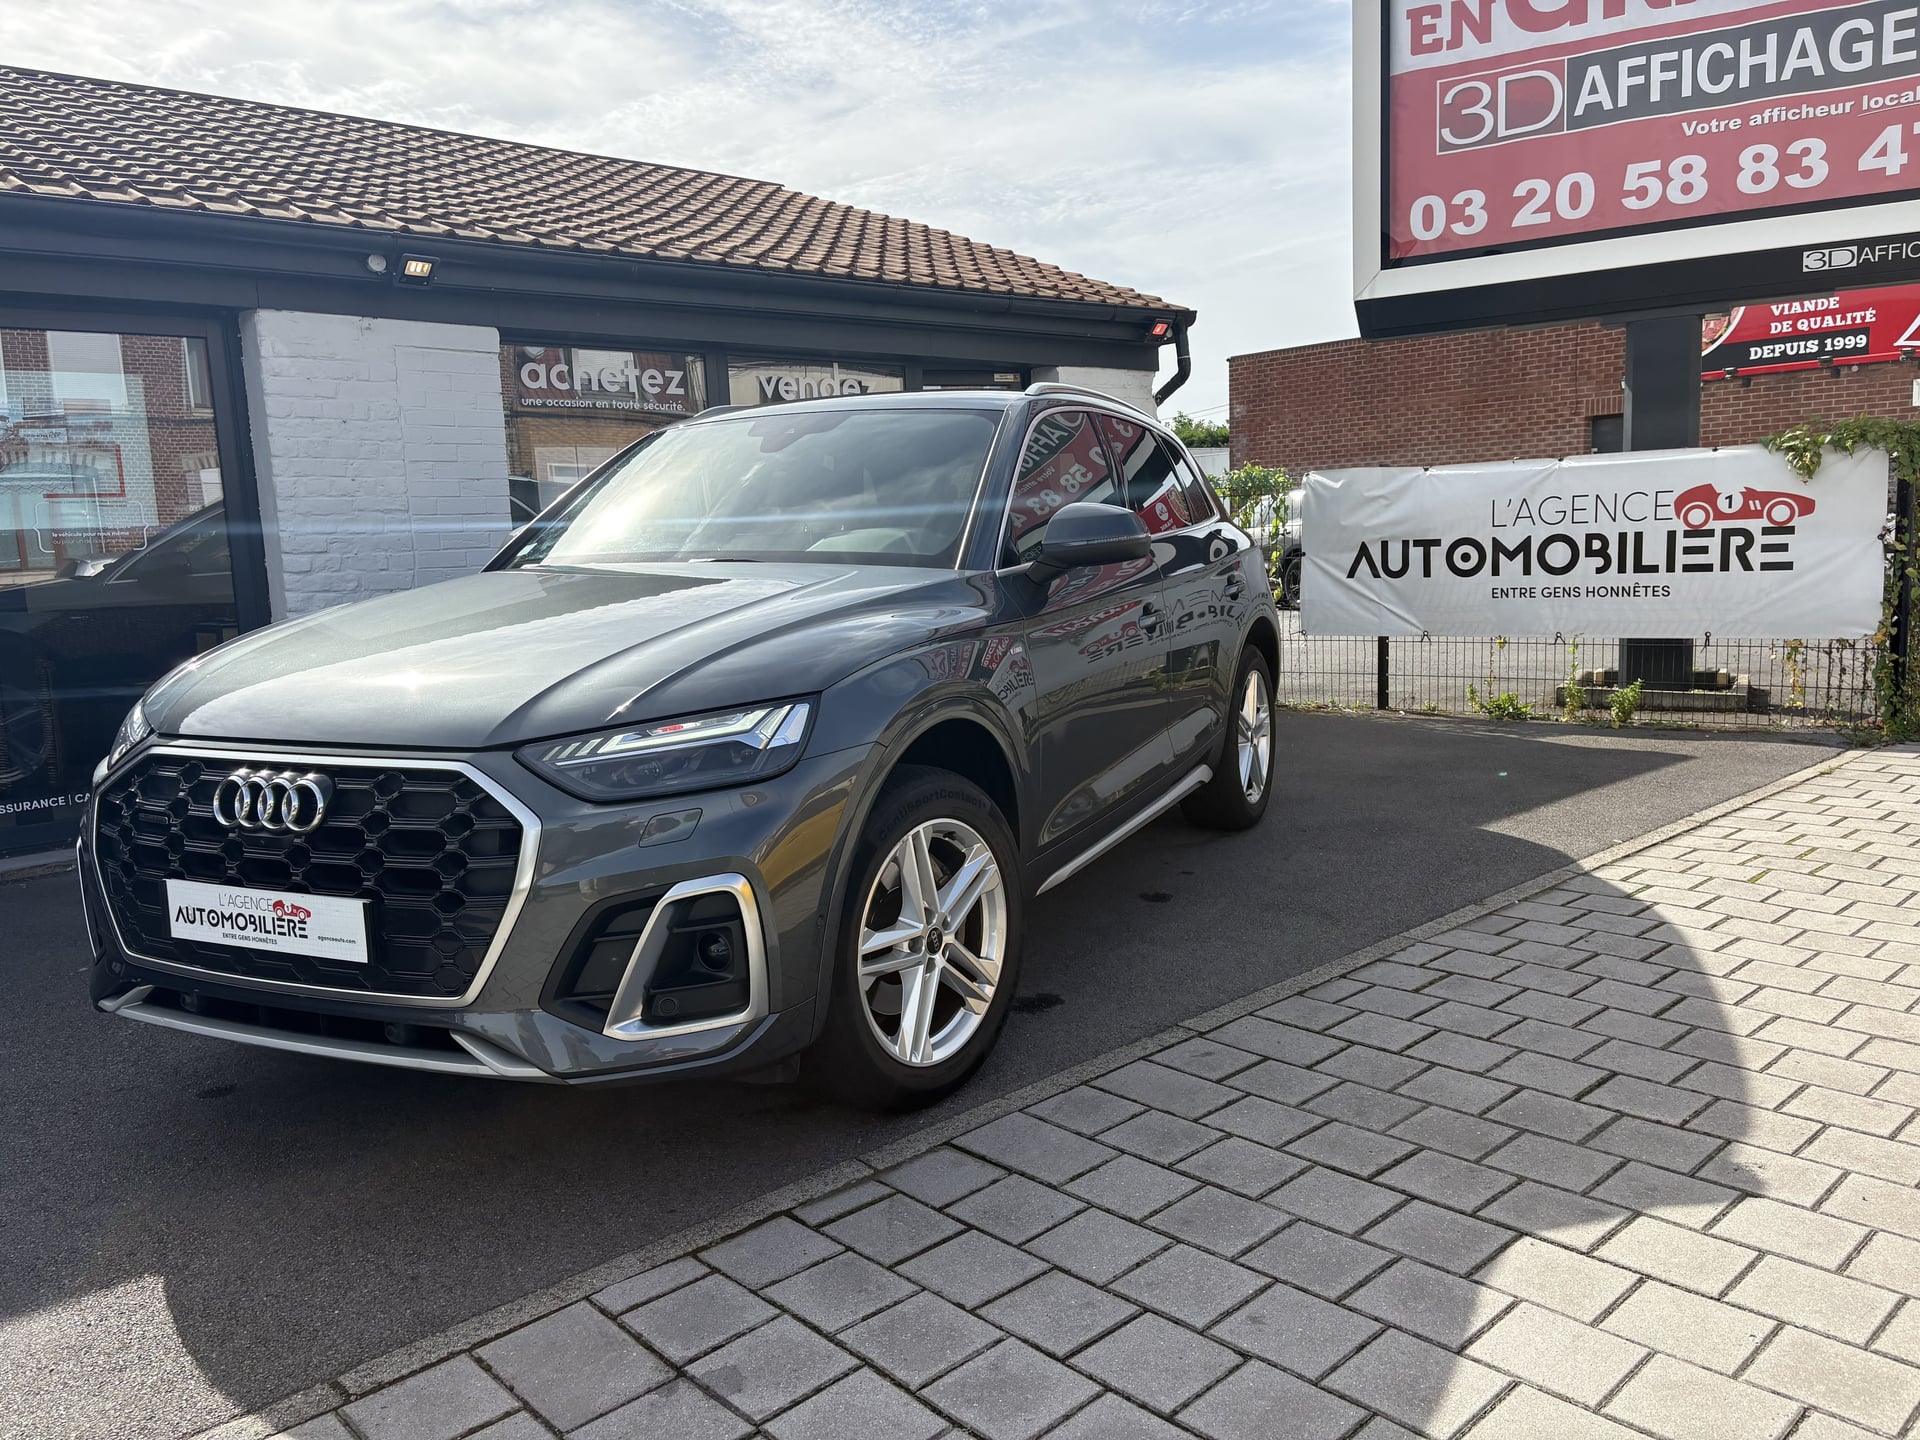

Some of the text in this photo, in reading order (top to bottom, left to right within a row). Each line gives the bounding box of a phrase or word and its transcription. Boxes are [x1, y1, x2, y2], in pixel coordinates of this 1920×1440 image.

[1440, 7, 1919, 146] 3D AFFICHAGE
[1681, 116, 1743, 137] Votre
[1749, 101, 1856, 127] afficheur
[1409, 121, 1920, 241] 03 20 58 83 4
[1804, 248, 1856, 270] 3D
[1770, 296, 1840, 317] VIANDE
[1770, 308, 1877, 335] DE QUALITÉ
[1749, 334, 1868, 361] DEPUIS 1999
[520, 358, 685, 395] achetez
[521, 398, 543, 407] une
[546, 396, 593, 409] occasion
[596, 401, 609, 409] en
[612, 399, 640, 410] toute
[1491, 490, 1674, 528] L'AGENCE
[1491, 582, 1671, 599] ENTRE GENS HONNÊTES
[218, 892, 273, 912] L'AGENCE
[222, 932, 238, 940] ENTRE
[238, 934, 251, 942] GENS
